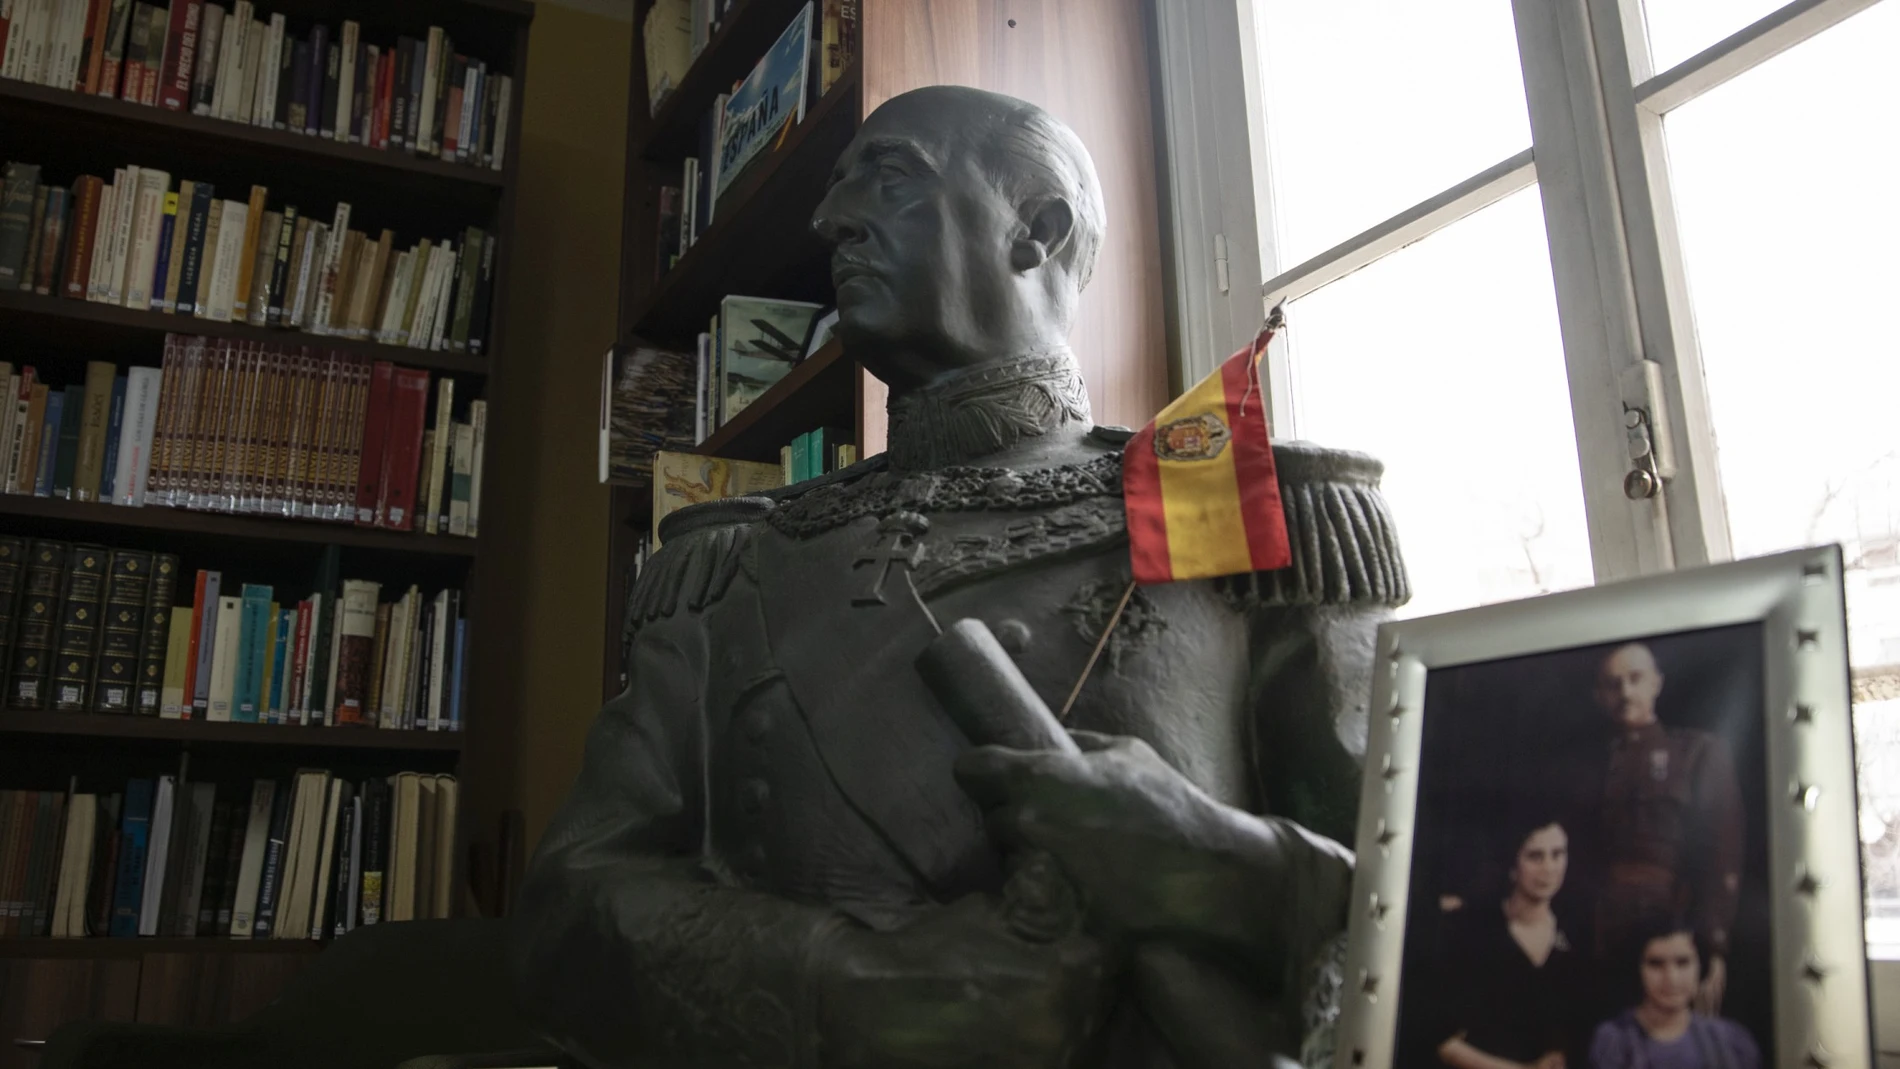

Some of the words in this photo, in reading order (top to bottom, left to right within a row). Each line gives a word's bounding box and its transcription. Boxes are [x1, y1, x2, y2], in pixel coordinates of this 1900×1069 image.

[184, 2, 199, 31] TRONO
[182, 31, 196, 47] DEL
[177, 46, 194, 79] PRECIO
[176, 79, 189, 91] EL
[719, 85, 779, 174] ESPAÑA
[186, 246, 197, 286] LICENCIA
